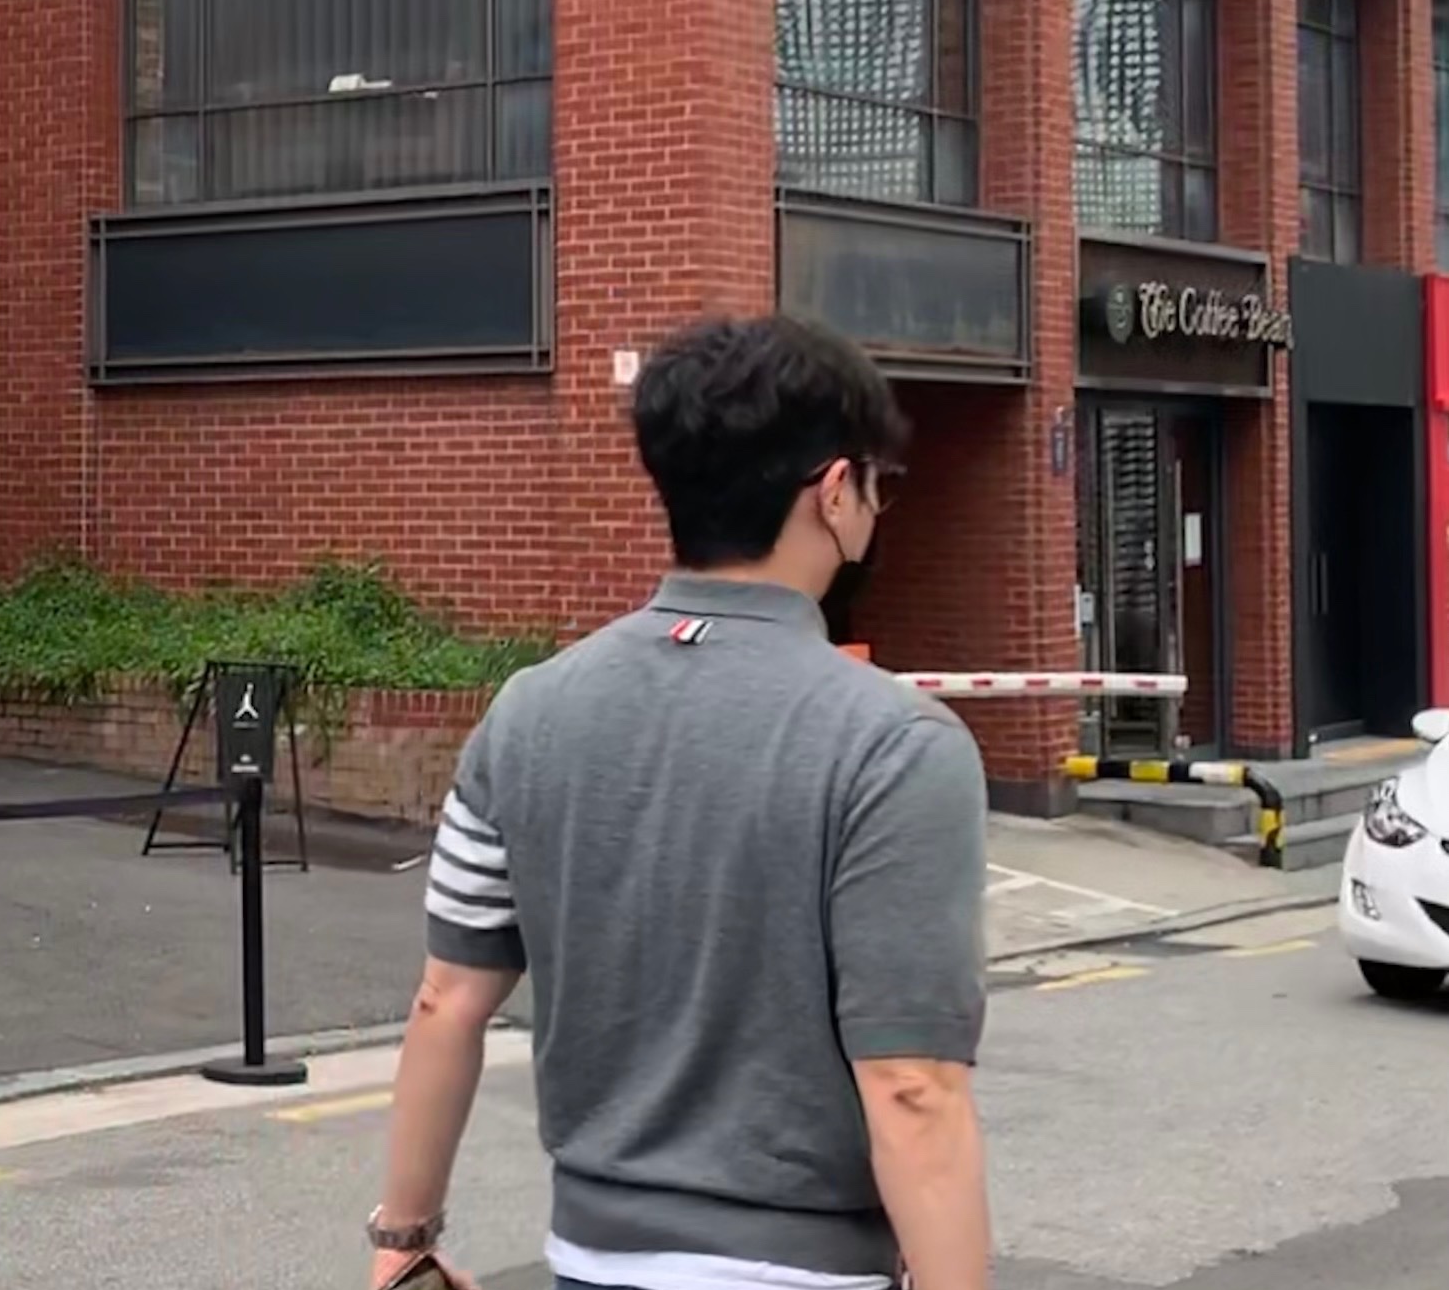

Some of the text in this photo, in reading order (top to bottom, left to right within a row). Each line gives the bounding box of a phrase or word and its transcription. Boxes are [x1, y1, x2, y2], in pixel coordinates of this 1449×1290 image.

[1138, 281, 1295, 350] The Coffee Bean
